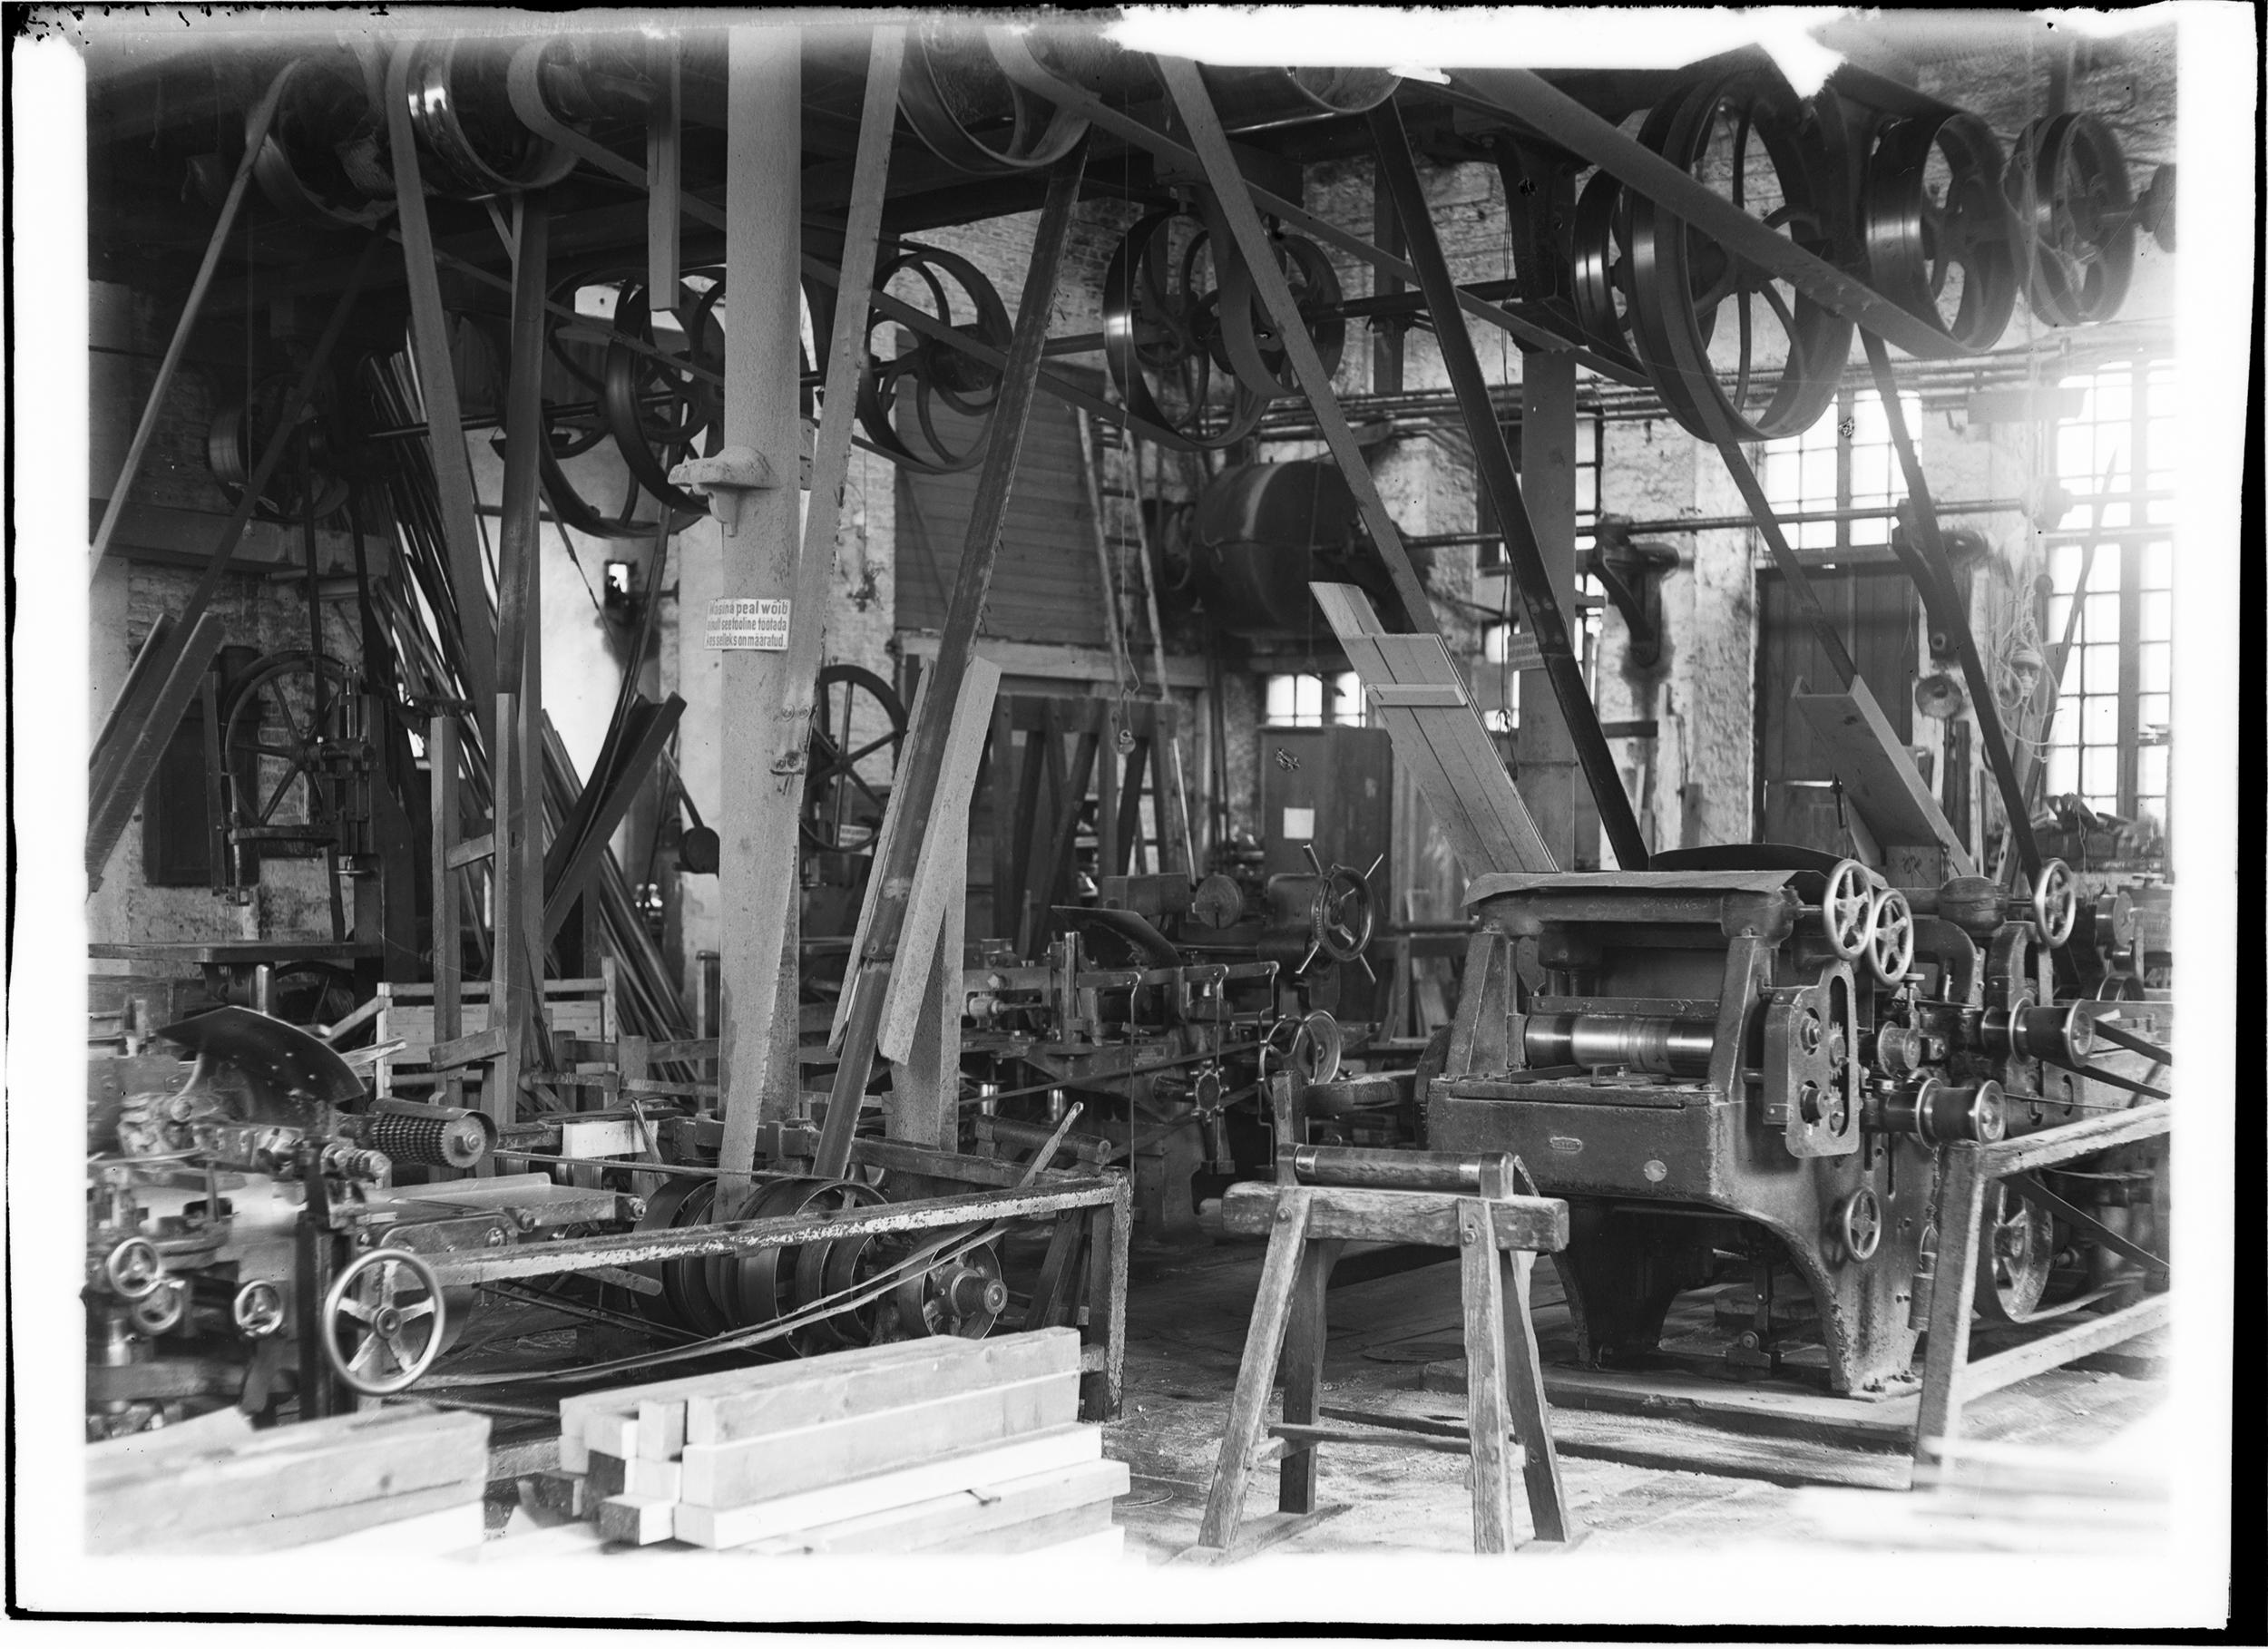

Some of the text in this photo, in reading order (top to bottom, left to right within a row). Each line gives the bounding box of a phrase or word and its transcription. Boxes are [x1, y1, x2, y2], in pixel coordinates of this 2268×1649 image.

[709, 600, 788, 617] Masina peal wõib
[758, 617, 787, 631] töötada
